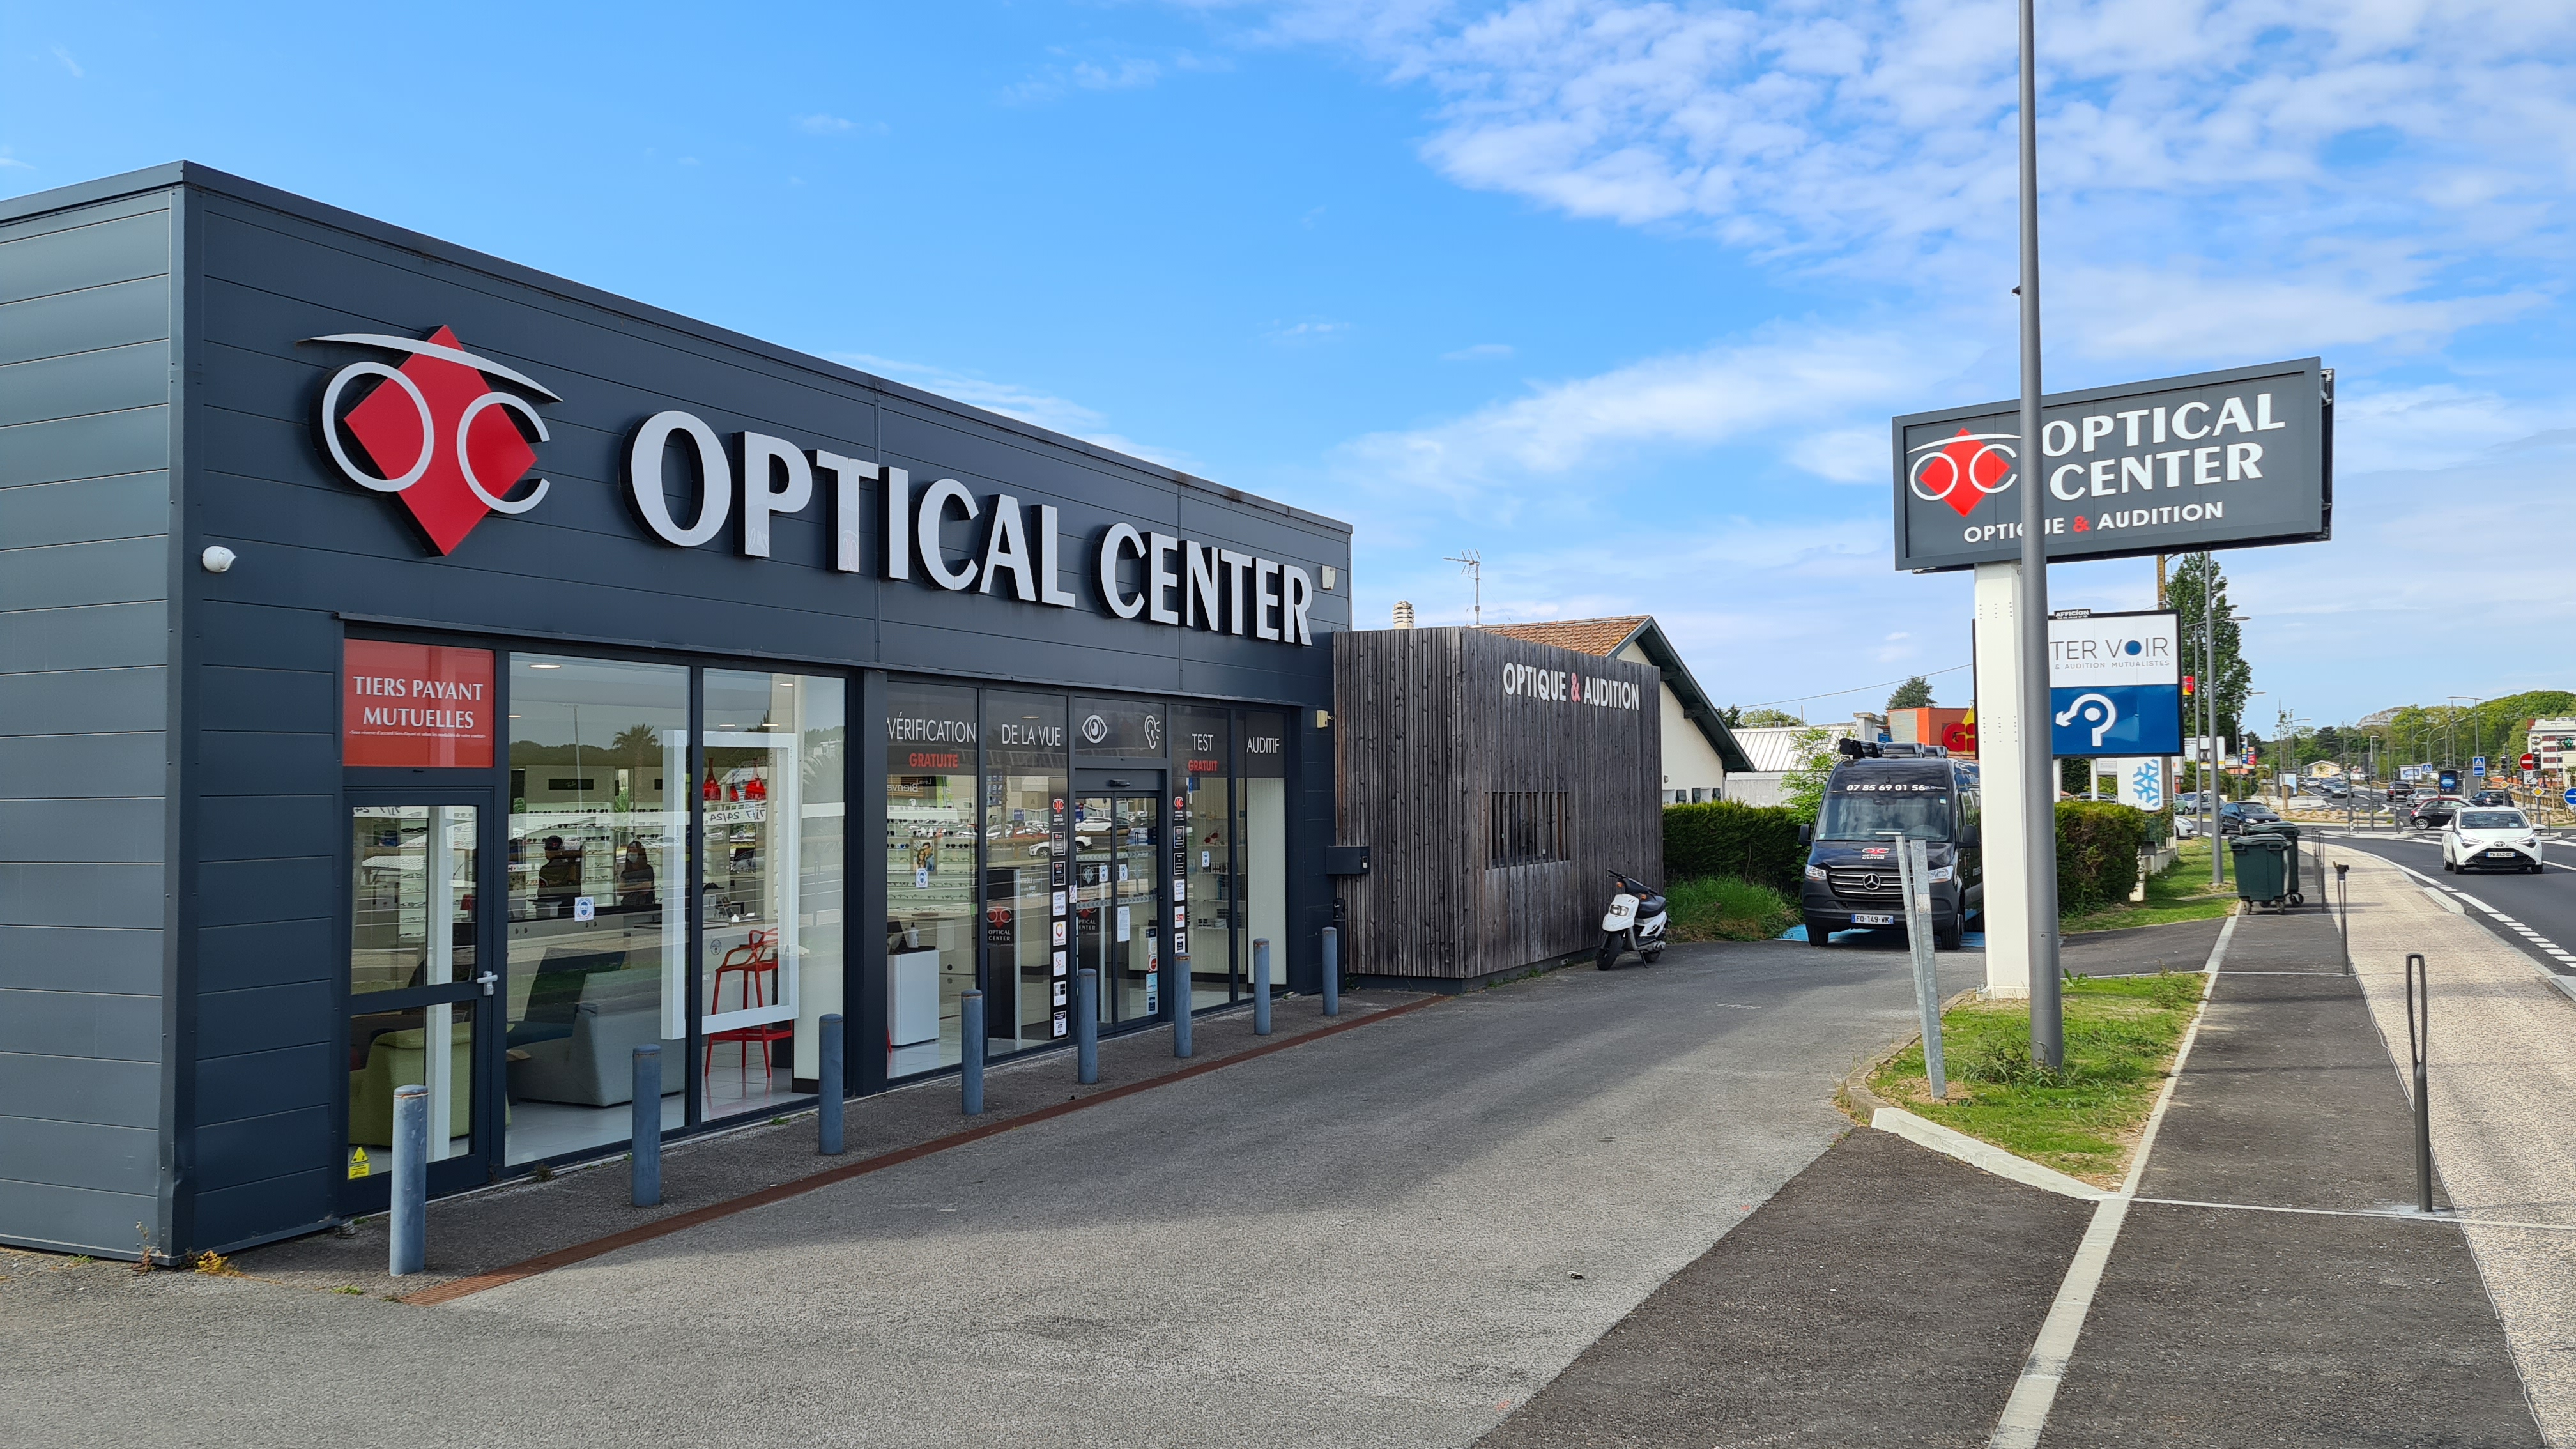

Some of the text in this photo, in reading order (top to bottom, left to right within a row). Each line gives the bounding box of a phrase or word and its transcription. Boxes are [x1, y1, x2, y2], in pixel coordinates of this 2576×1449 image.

[2043, 393, 2285, 457] OPTICAL
[2049, 442, 2264, 501] CENTER
[630, 410, 1313, 646] OPTICAL CENTER
[1963, 501, 2224, 544] OPTIE & AUDITION
[2112, 660, 2170, 668] MUTUALISTES
[353, 676, 483, 701] TIERS PAYANT
[1503, 662, 1640, 710] OPTIQUE & AUDITION
[363, 707, 474, 729] MUTUELLES
[887, 711, 1061, 746] VÉRIFICATION DE LA VUE
[1192, 733, 1280, 754] TEST AUDITIF
[909, 752, 958, 769] GRATUITE
[1188, 760, 1218, 772] GRATUIT
